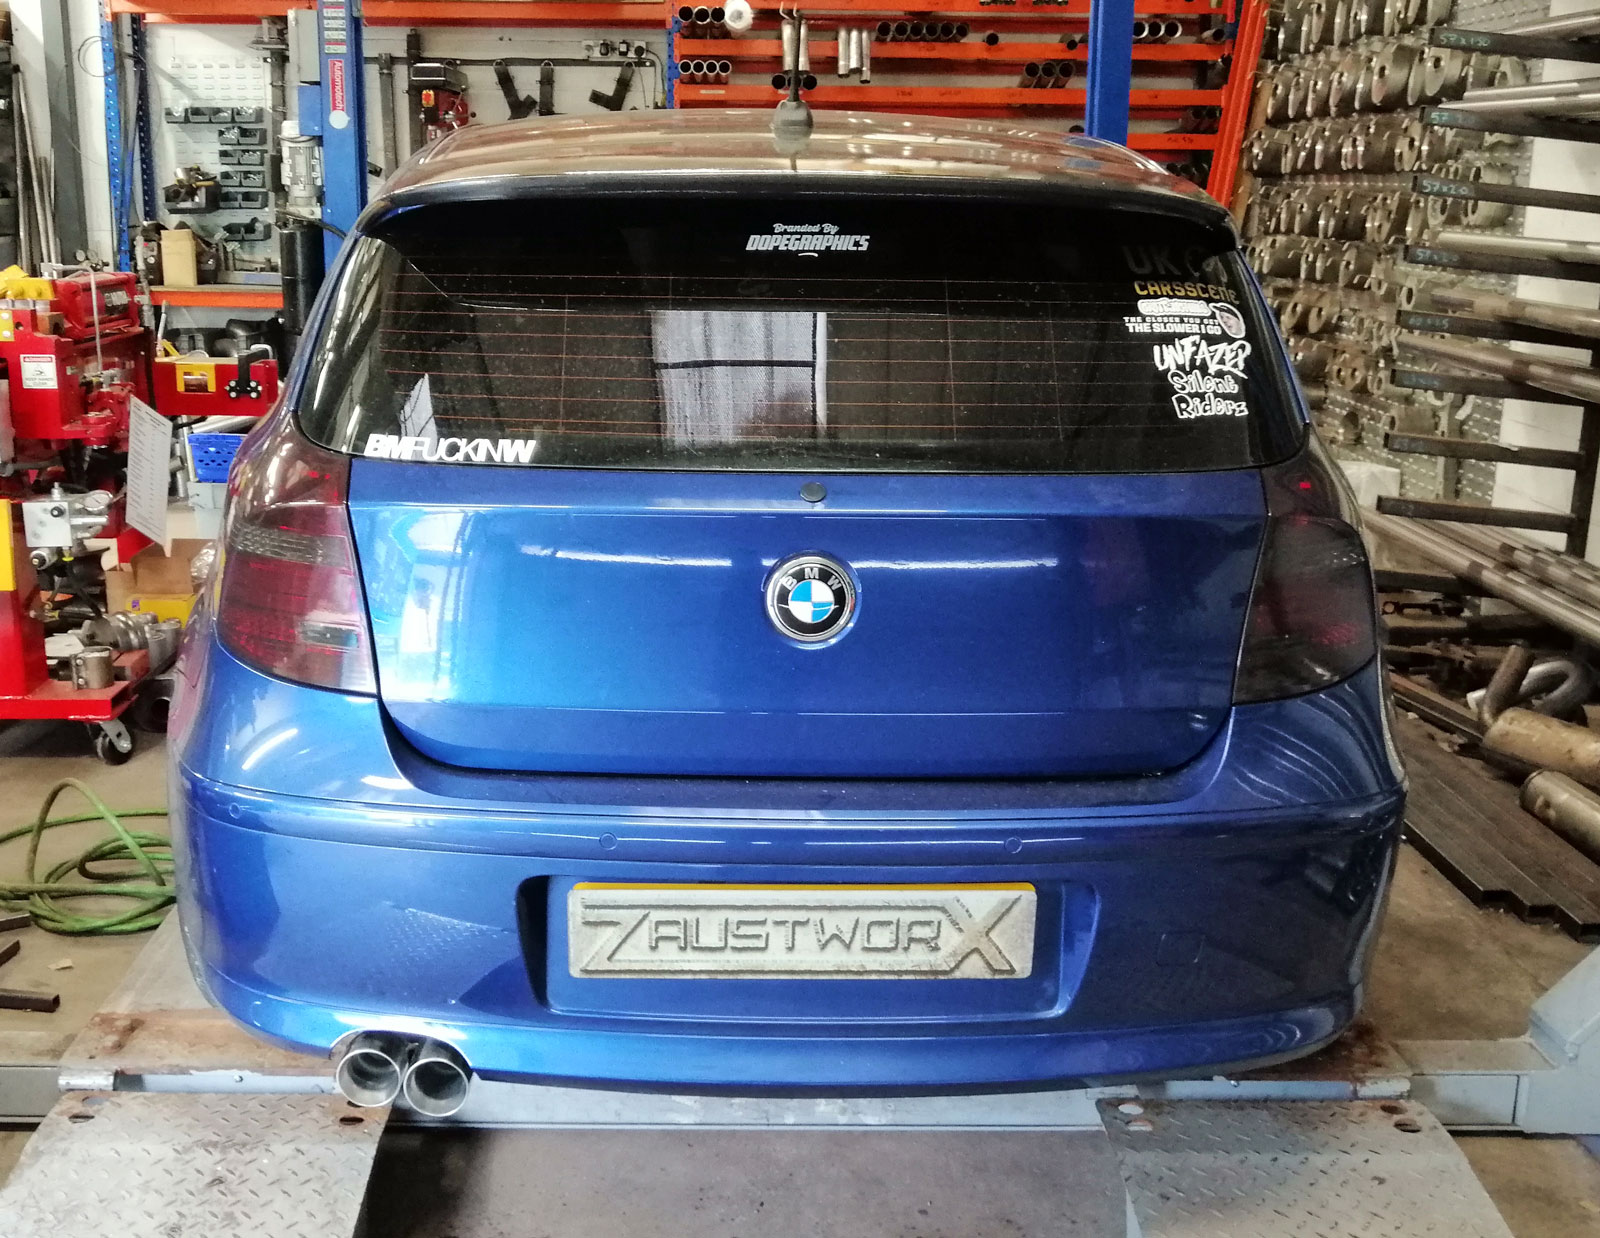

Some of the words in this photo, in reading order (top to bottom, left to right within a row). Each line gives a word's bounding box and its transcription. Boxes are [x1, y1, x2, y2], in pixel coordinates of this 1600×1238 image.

[333, 61, 345, 110] Automotech
[772, 223, 821, 233] Branded
[821, 223, 839, 235] By
[745, 234, 870, 251] DOPEGRAPHICS
[1125, 323, 1151, 333] THE
[1152, 323, 1200, 333] SLOWER
[1207, 325, 1222, 335] GO
[1168, 370, 1239, 393] Silent
[780, 567, 841, 591] BMW
